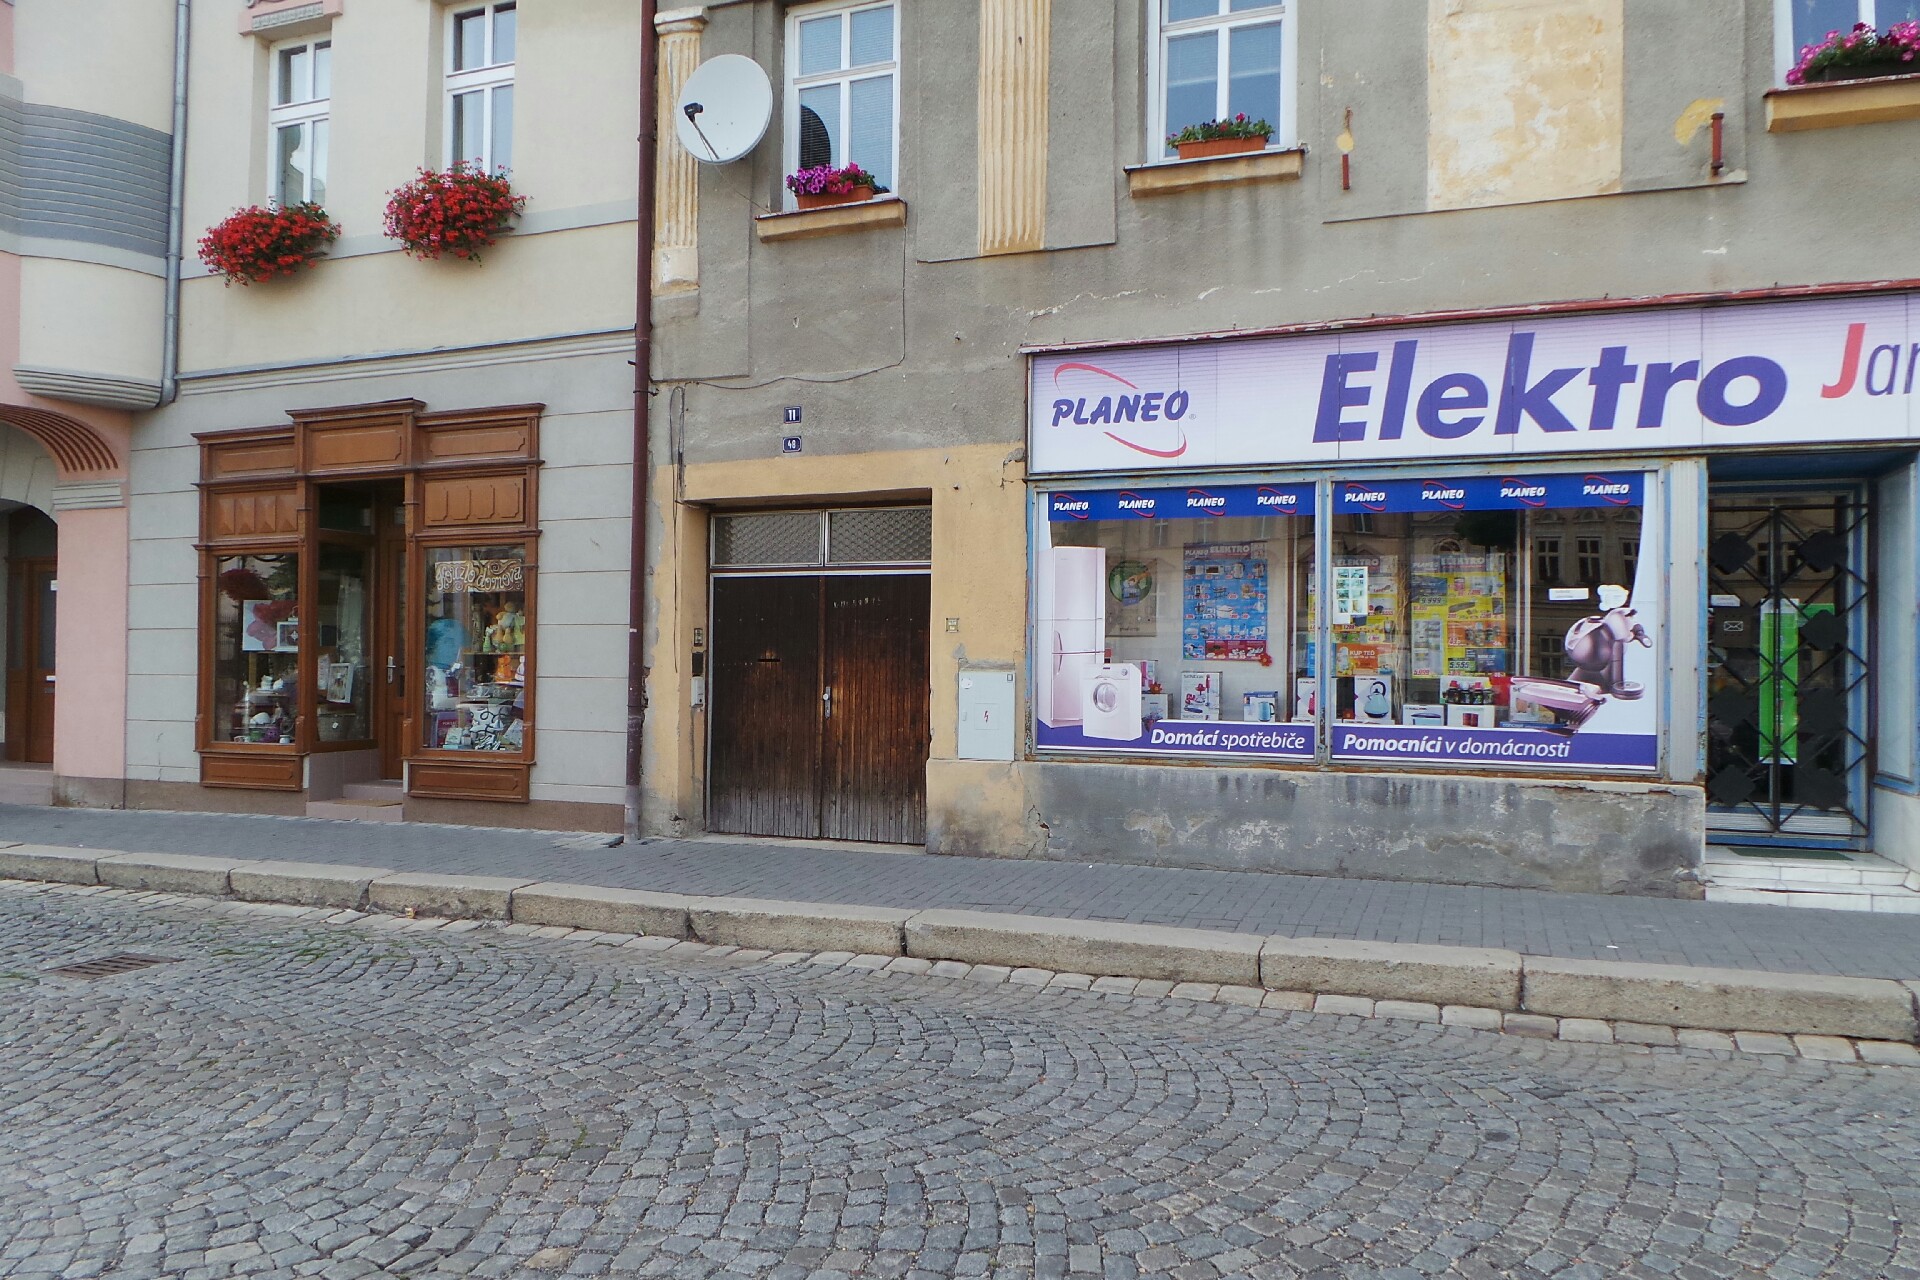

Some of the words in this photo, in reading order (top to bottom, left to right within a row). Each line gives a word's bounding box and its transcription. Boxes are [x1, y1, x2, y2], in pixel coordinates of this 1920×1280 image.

[1312, 332, 1788, 443] Elektro
[1052, 390, 1189, 427] PLANEO
[788, 409, 796, 421] 11
[787, 439, 796, 449] 48
[1421, 489, 1465, 500] PLANEO
[1500, 487, 1546, 498] PLANEO
[1582, 484, 1630, 495] PLANEO
[1187, 497, 1225, 507] PLANEO
[1257, 495, 1297, 505] PLANEO
[1344, 492, 1386, 503] PLANEO
[1053, 501, 1089, 511] PLANEO
[1118, 499, 1155, 509] PLANEO
[1209, 544, 1250, 554] ELEKTRO
[1337, 558, 1380, 567] ELEKTRO
[476, 565, 523, 589] domova
[1151, 728, 1220, 746] Domácí
[1220, 731, 1305, 750] spotřebiče
[1343, 733, 1443, 753] Pomocníci
[1445, 740, 1456, 753] v
[1458, 737, 1570, 757] domácnosti
